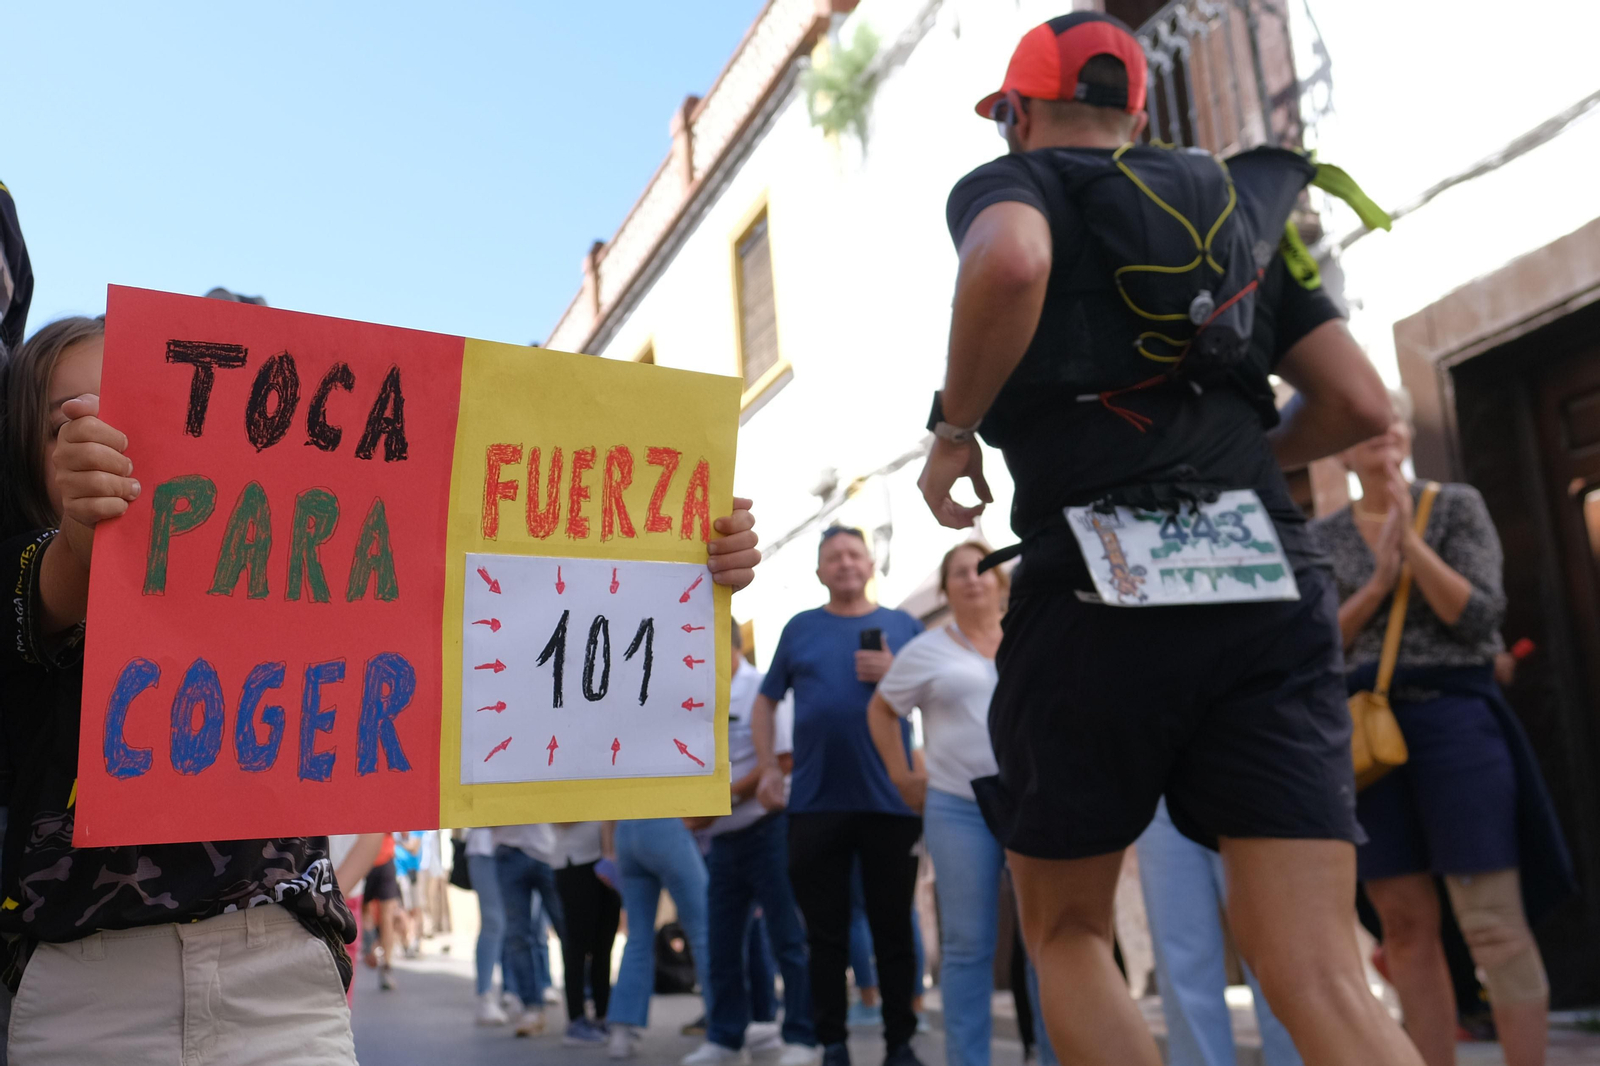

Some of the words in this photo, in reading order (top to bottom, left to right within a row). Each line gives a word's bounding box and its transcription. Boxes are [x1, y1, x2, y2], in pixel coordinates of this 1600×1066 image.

[166, 339, 409, 463] TOCA
[142, 475, 399, 603] PARA
[481, 443, 711, 543] FUERZA
[1159, 510, 1252, 545] 443
[536, 609, 655, 709] 101
[102, 652, 416, 782] COGER
